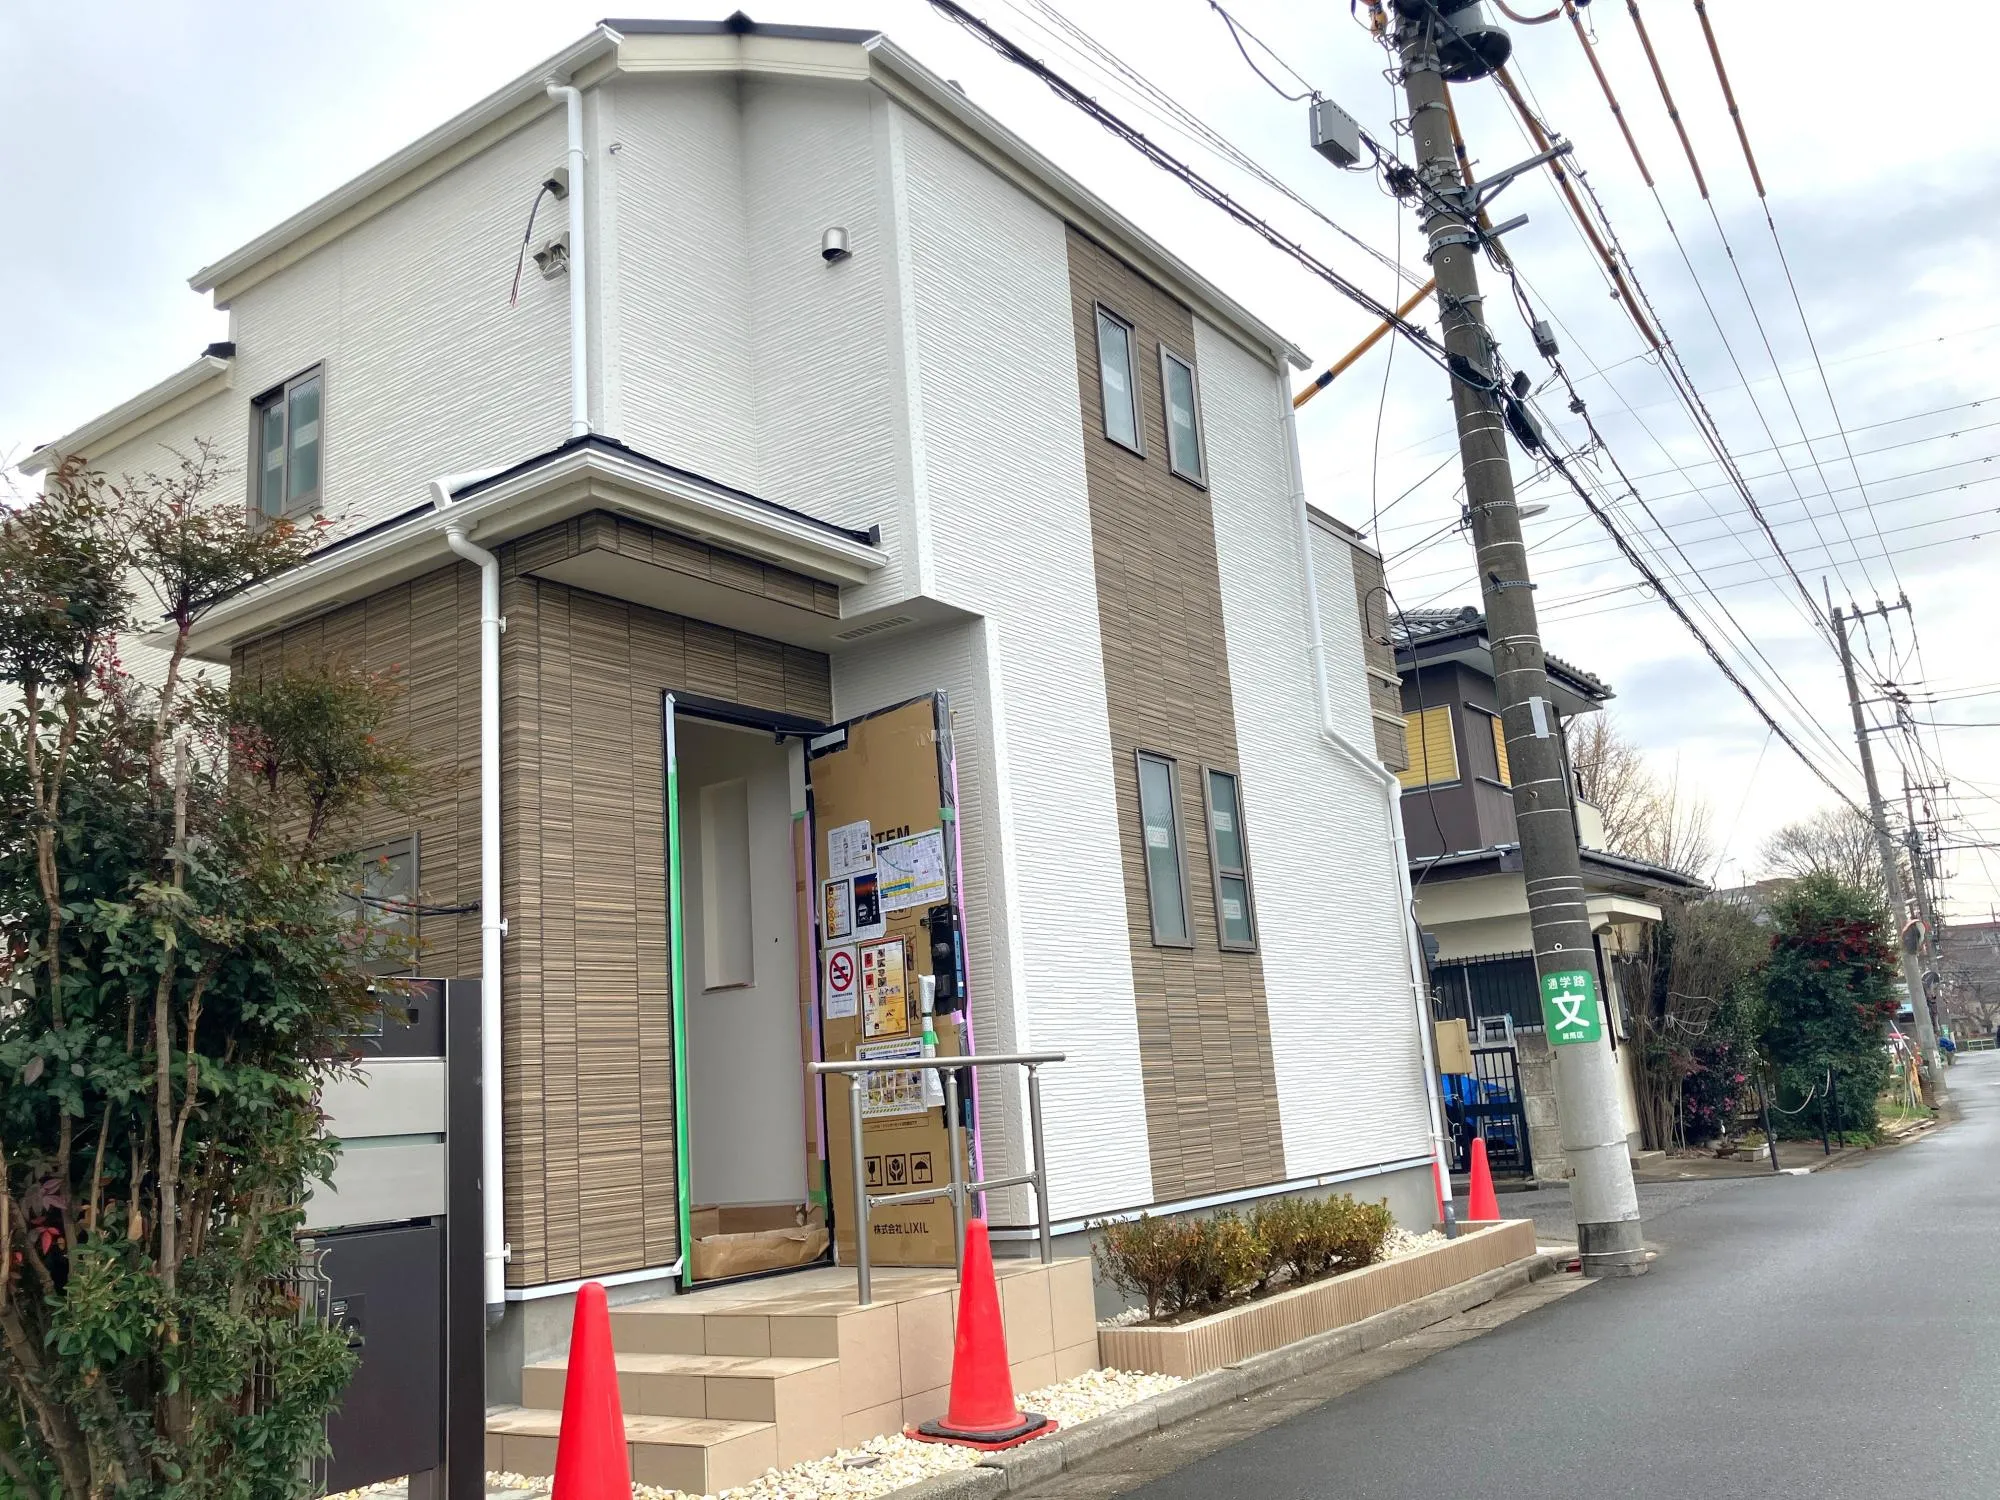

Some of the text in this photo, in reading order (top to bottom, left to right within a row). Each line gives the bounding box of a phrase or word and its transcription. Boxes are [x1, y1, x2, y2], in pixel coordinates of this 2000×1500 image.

[1547, 975, 1585, 990] 通学路
[1551, 990, 1590, 1031] 文
[904, 1222, 929, 1234] LIXIL
